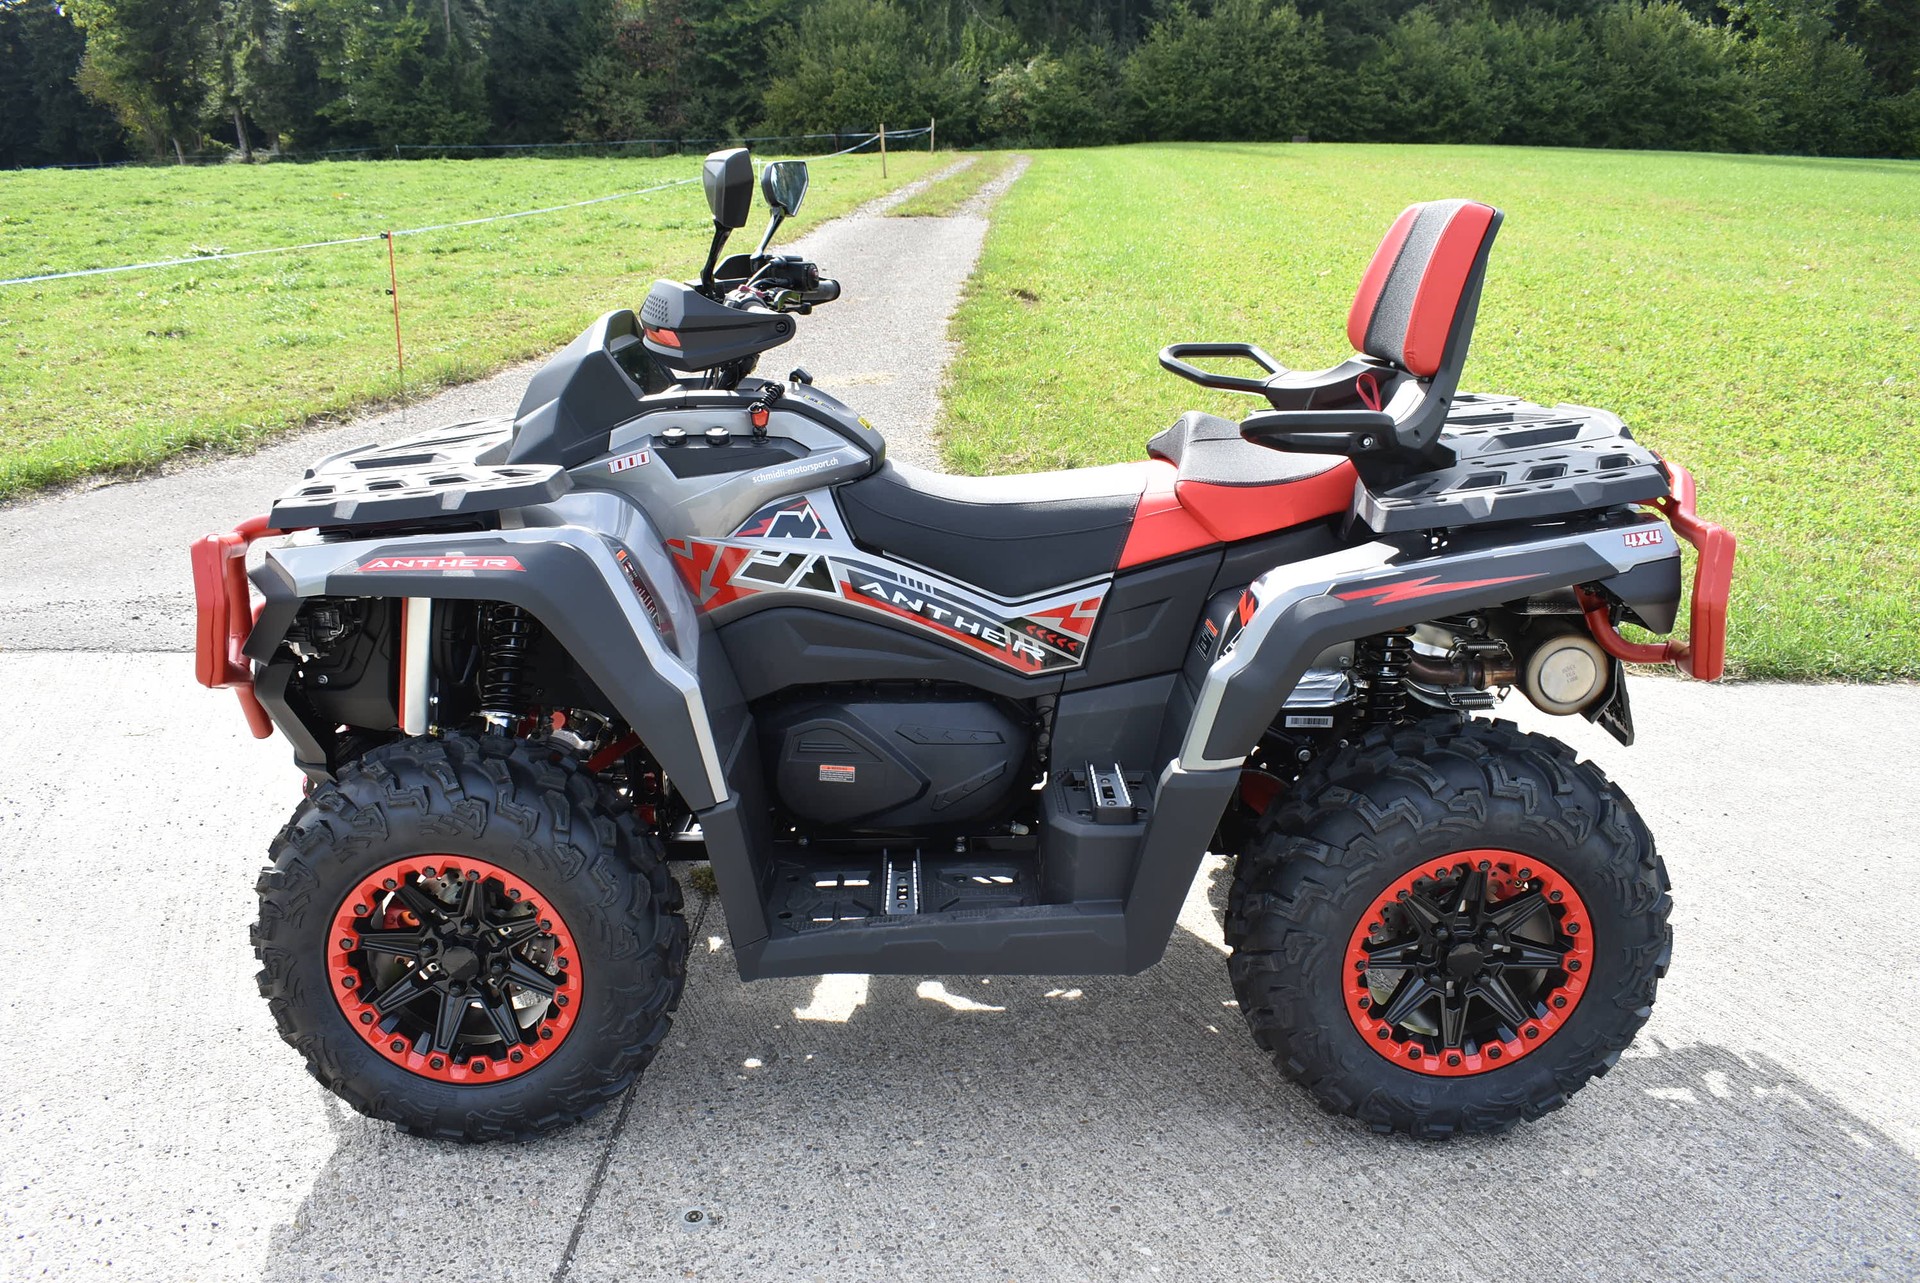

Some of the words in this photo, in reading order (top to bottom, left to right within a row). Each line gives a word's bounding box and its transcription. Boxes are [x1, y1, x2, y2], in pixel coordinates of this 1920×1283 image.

[608, 450, 650, 474] 1000
[752, 456, 839, 483] schmidli-motorsport.ch
[368, 558, 508, 569] ANTHER
[859, 581, 1047, 662] ANTHER
